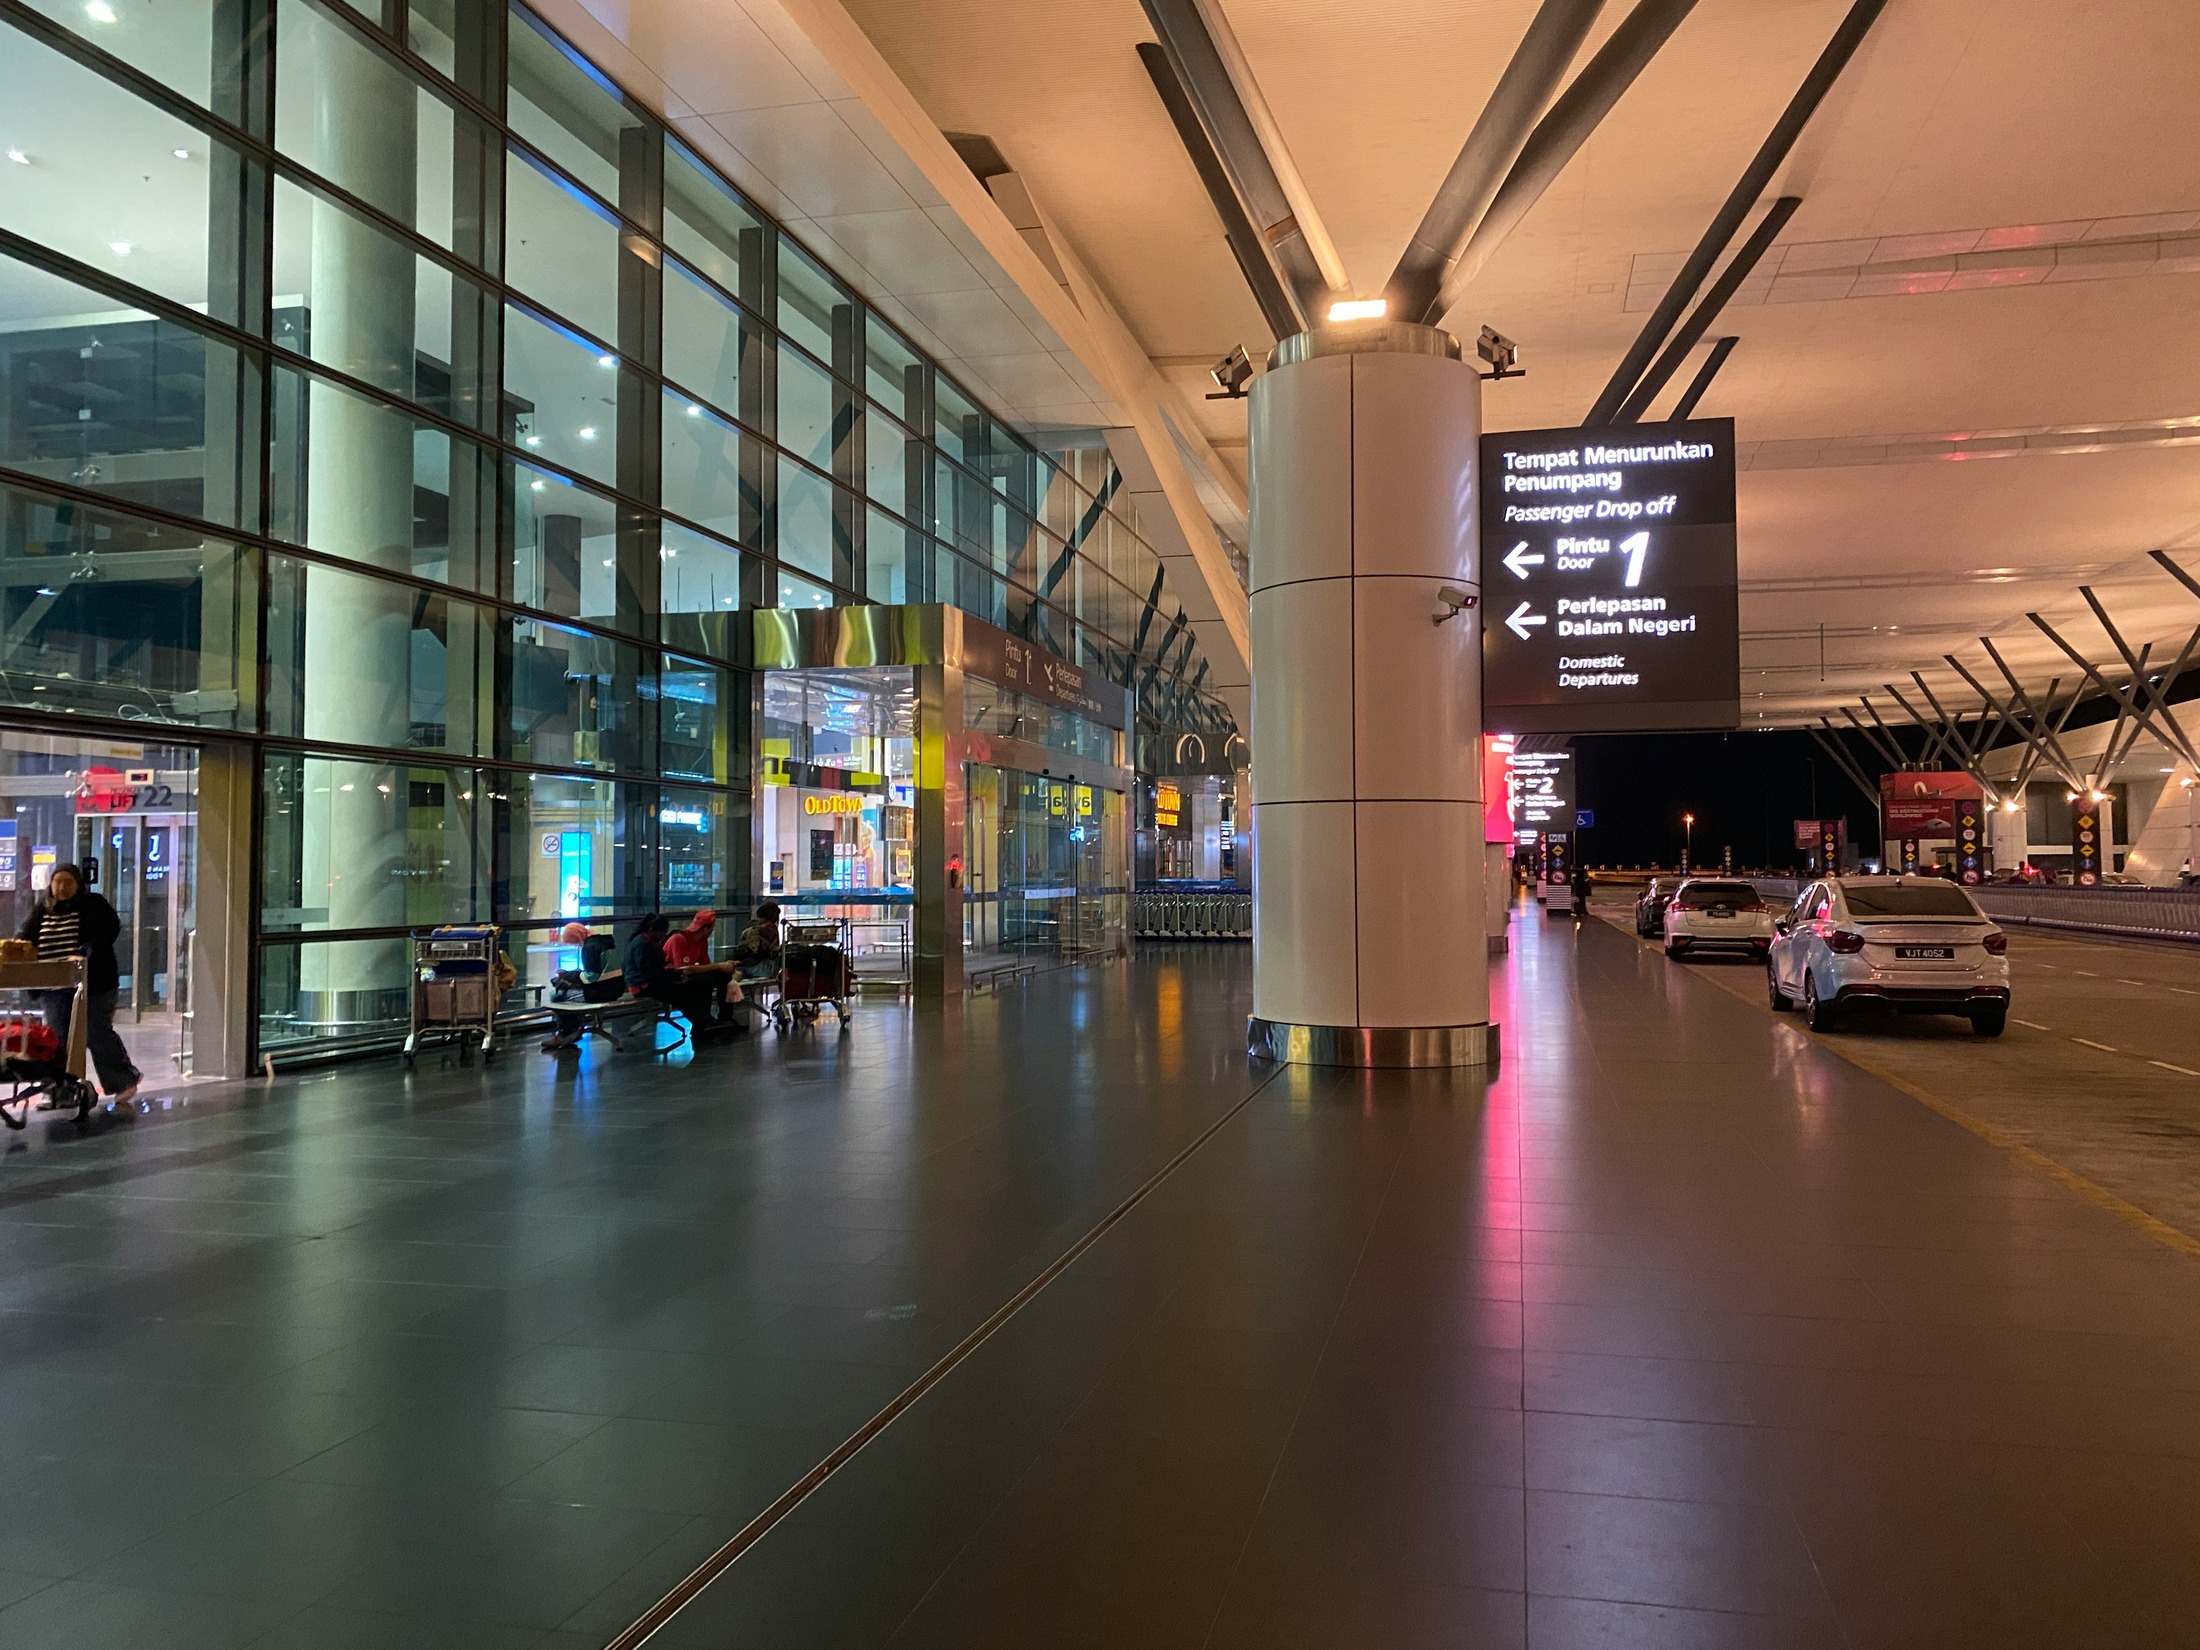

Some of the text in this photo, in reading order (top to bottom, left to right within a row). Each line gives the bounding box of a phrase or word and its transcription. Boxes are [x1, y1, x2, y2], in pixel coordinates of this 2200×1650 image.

[1503, 441, 1714, 471] Tempat Menurunkan
[1503, 470, 1622, 493] Penumpang
[1504, 495, 1677, 523] Passenger Drop off
[1556, 532, 1650, 587] Pintu 1
[1557, 556, 1595, 570] Door
[1557, 596, 1666, 617] Perlepasan
[1558, 615, 1696, 637] Dalam Negeri
[1559, 654, 1625, 670] Domestic
[1559, 673, 1639, 690] Departures
[1539, 777, 1554, 793] 2
[110, 794, 138, 808] LIFT
[144, 785, 173, 807] 22
[1905, 949, 1945, 958] VJT 4052
